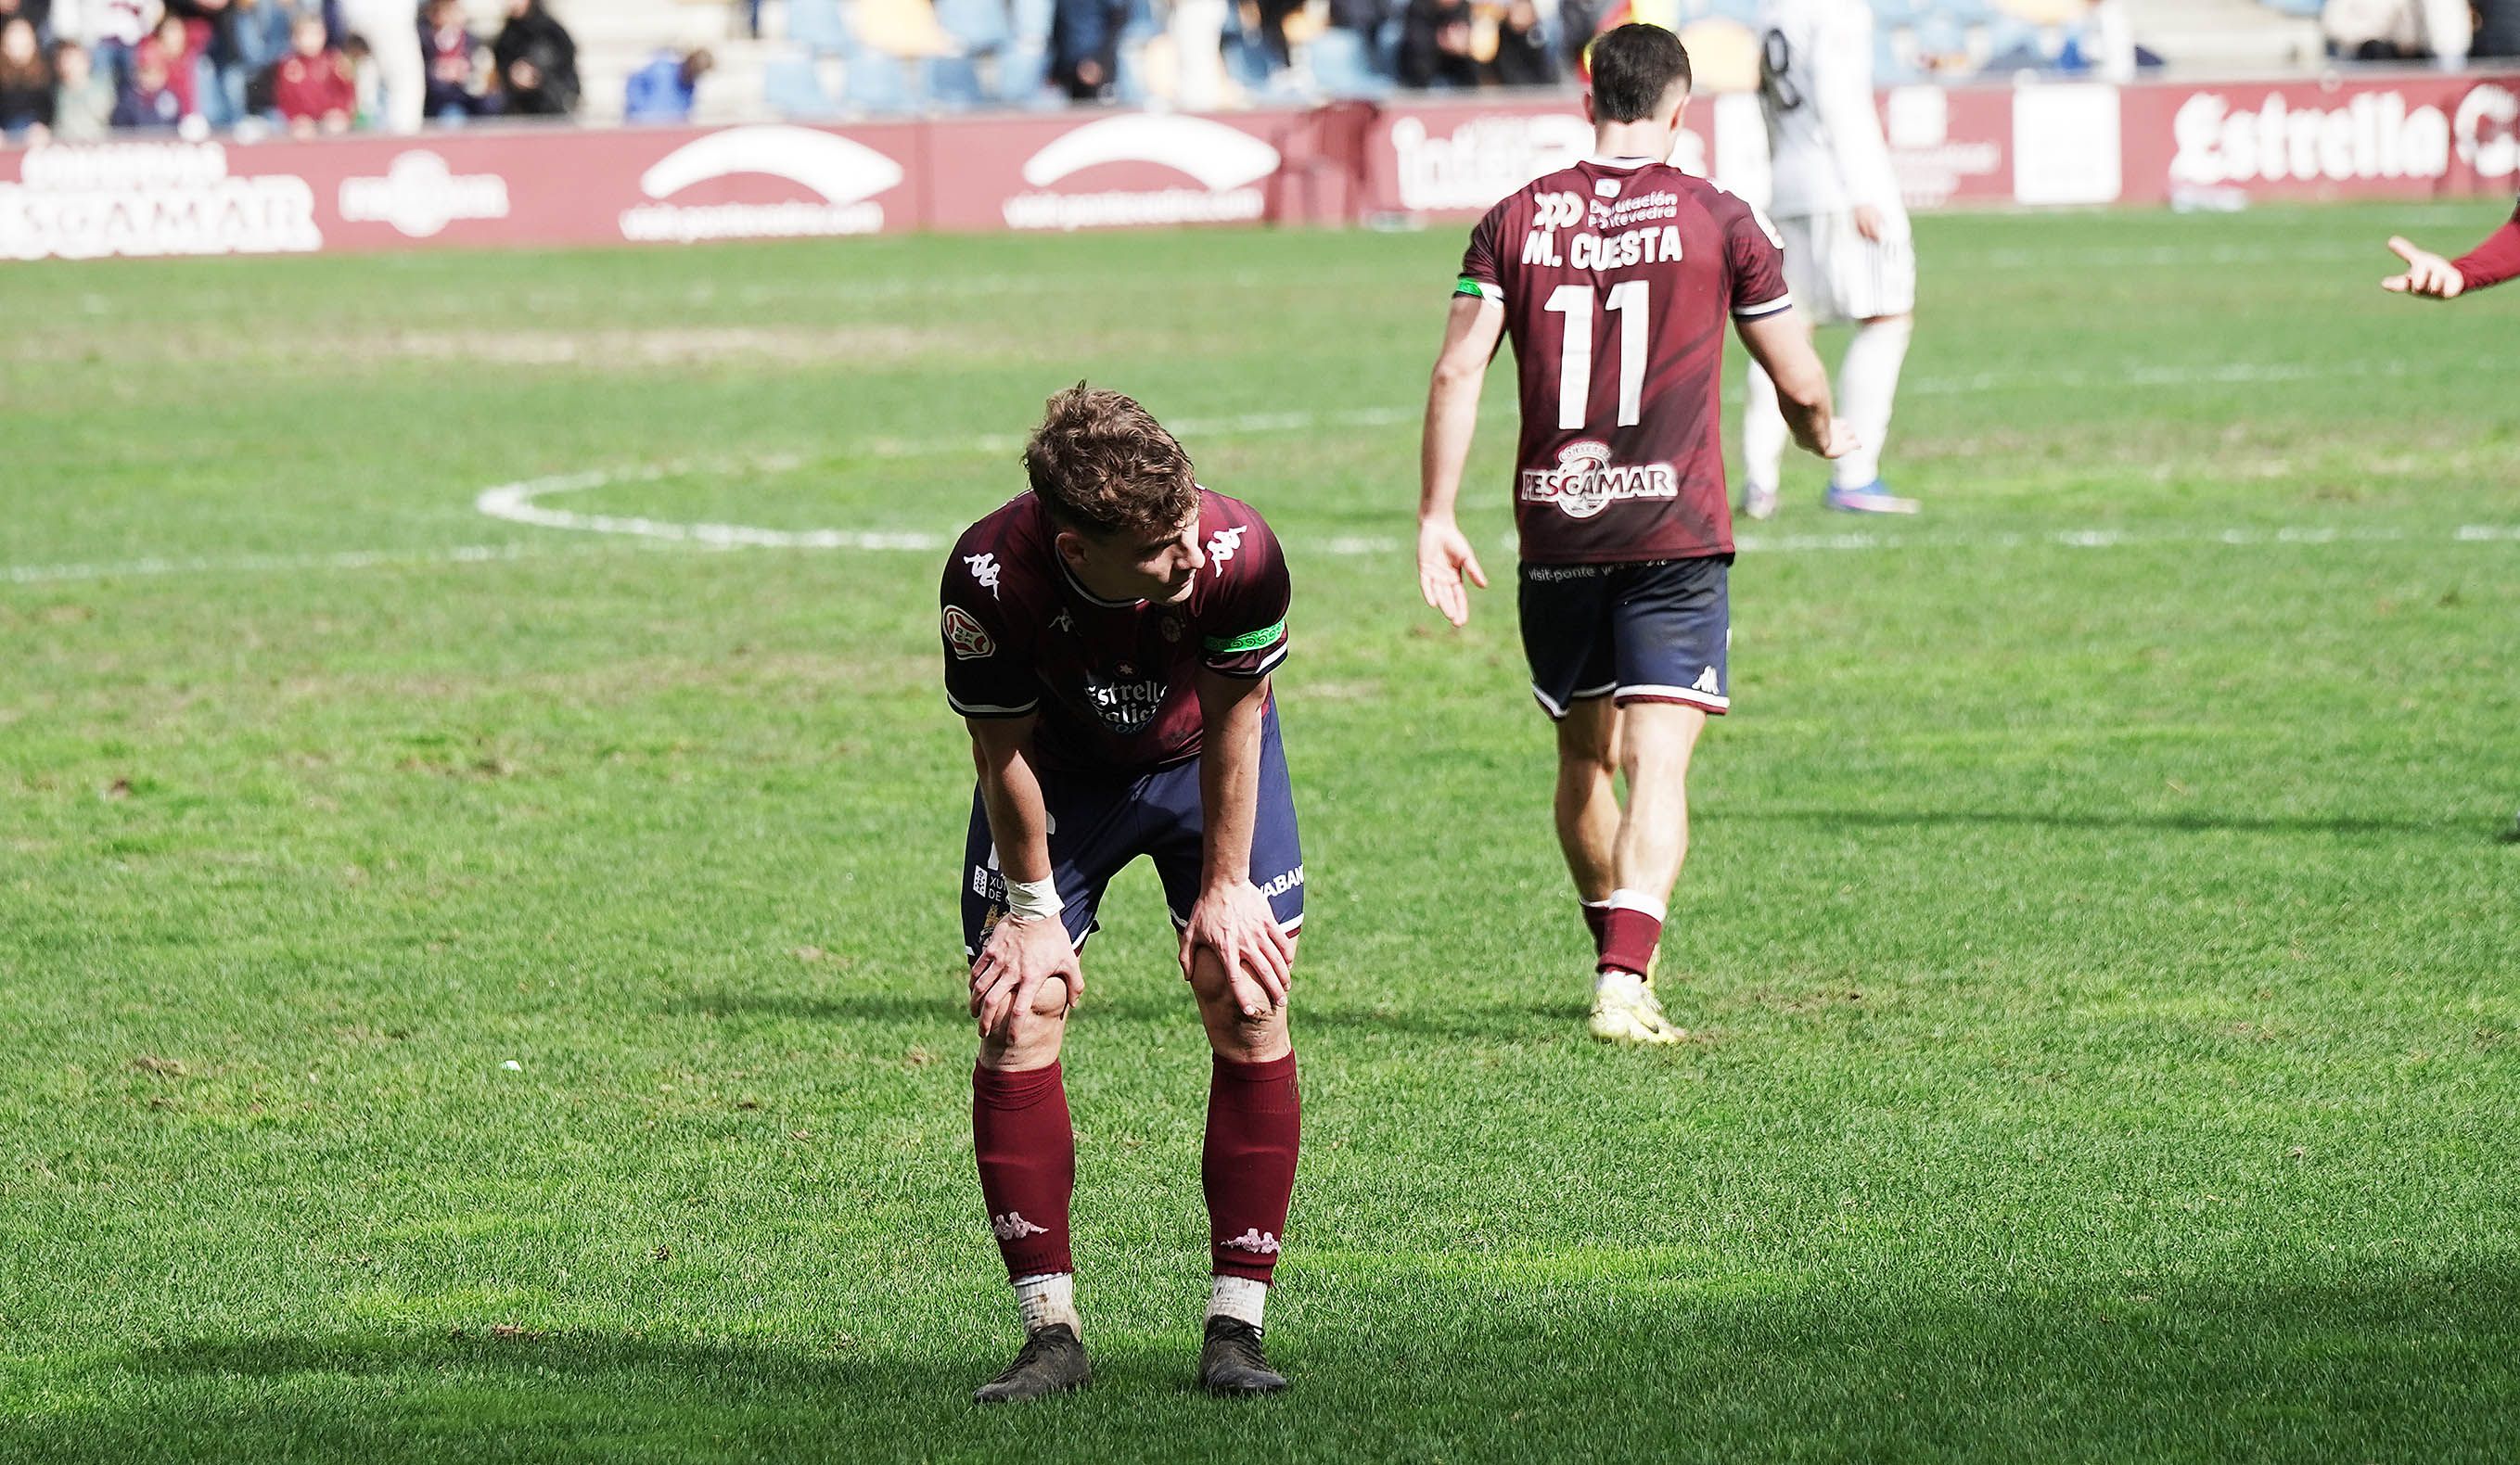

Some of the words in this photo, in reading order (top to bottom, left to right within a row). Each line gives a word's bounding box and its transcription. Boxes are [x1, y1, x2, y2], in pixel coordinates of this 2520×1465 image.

[1521, 229, 1564, 268] M.
[1569, 224, 1683, 272] CUESTA
[1542, 279, 1650, 431] 11
[988, 888, 1003, 902] DE
